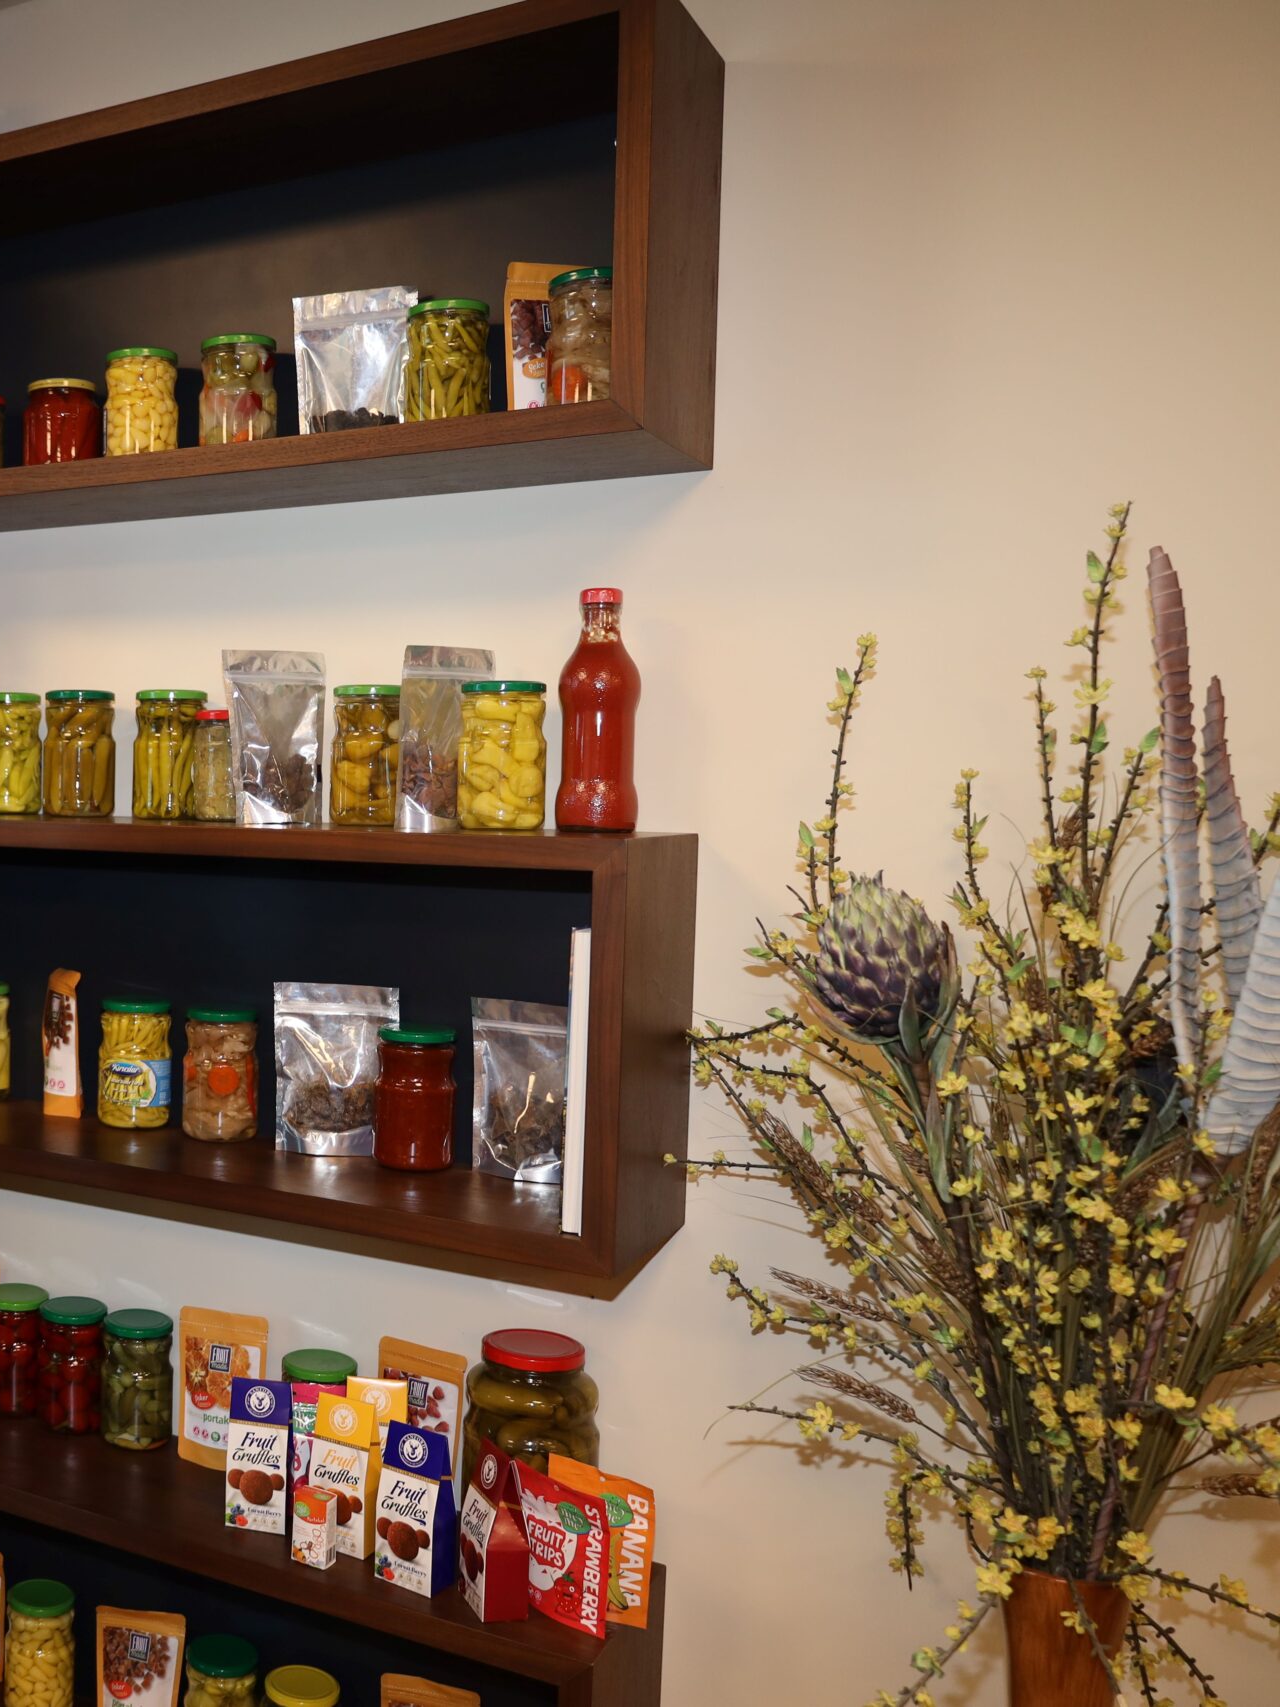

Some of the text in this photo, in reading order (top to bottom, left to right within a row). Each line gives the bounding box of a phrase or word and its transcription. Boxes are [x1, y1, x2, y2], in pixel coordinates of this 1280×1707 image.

[203, 1413, 230, 1425] portak
[240, 1431, 278, 1451] Fruit
[232, 1447, 281, 1467] Truffles
[322, 1449, 358, 1472] Fruit
[314, 1464, 360, 1486] Truffles
[390, 1480, 427, 1505] Fruit
[381, 1495, 429, 1520] Truffles
[469, 1499, 489, 1526] Fruit
[528, 1520, 564, 1549] FRUIT
[530, 1536, 563, 1567] TRIPS
[618, 1493, 650, 1607] BANANA
[580, 1503, 604, 1634] STRAWBERRY
